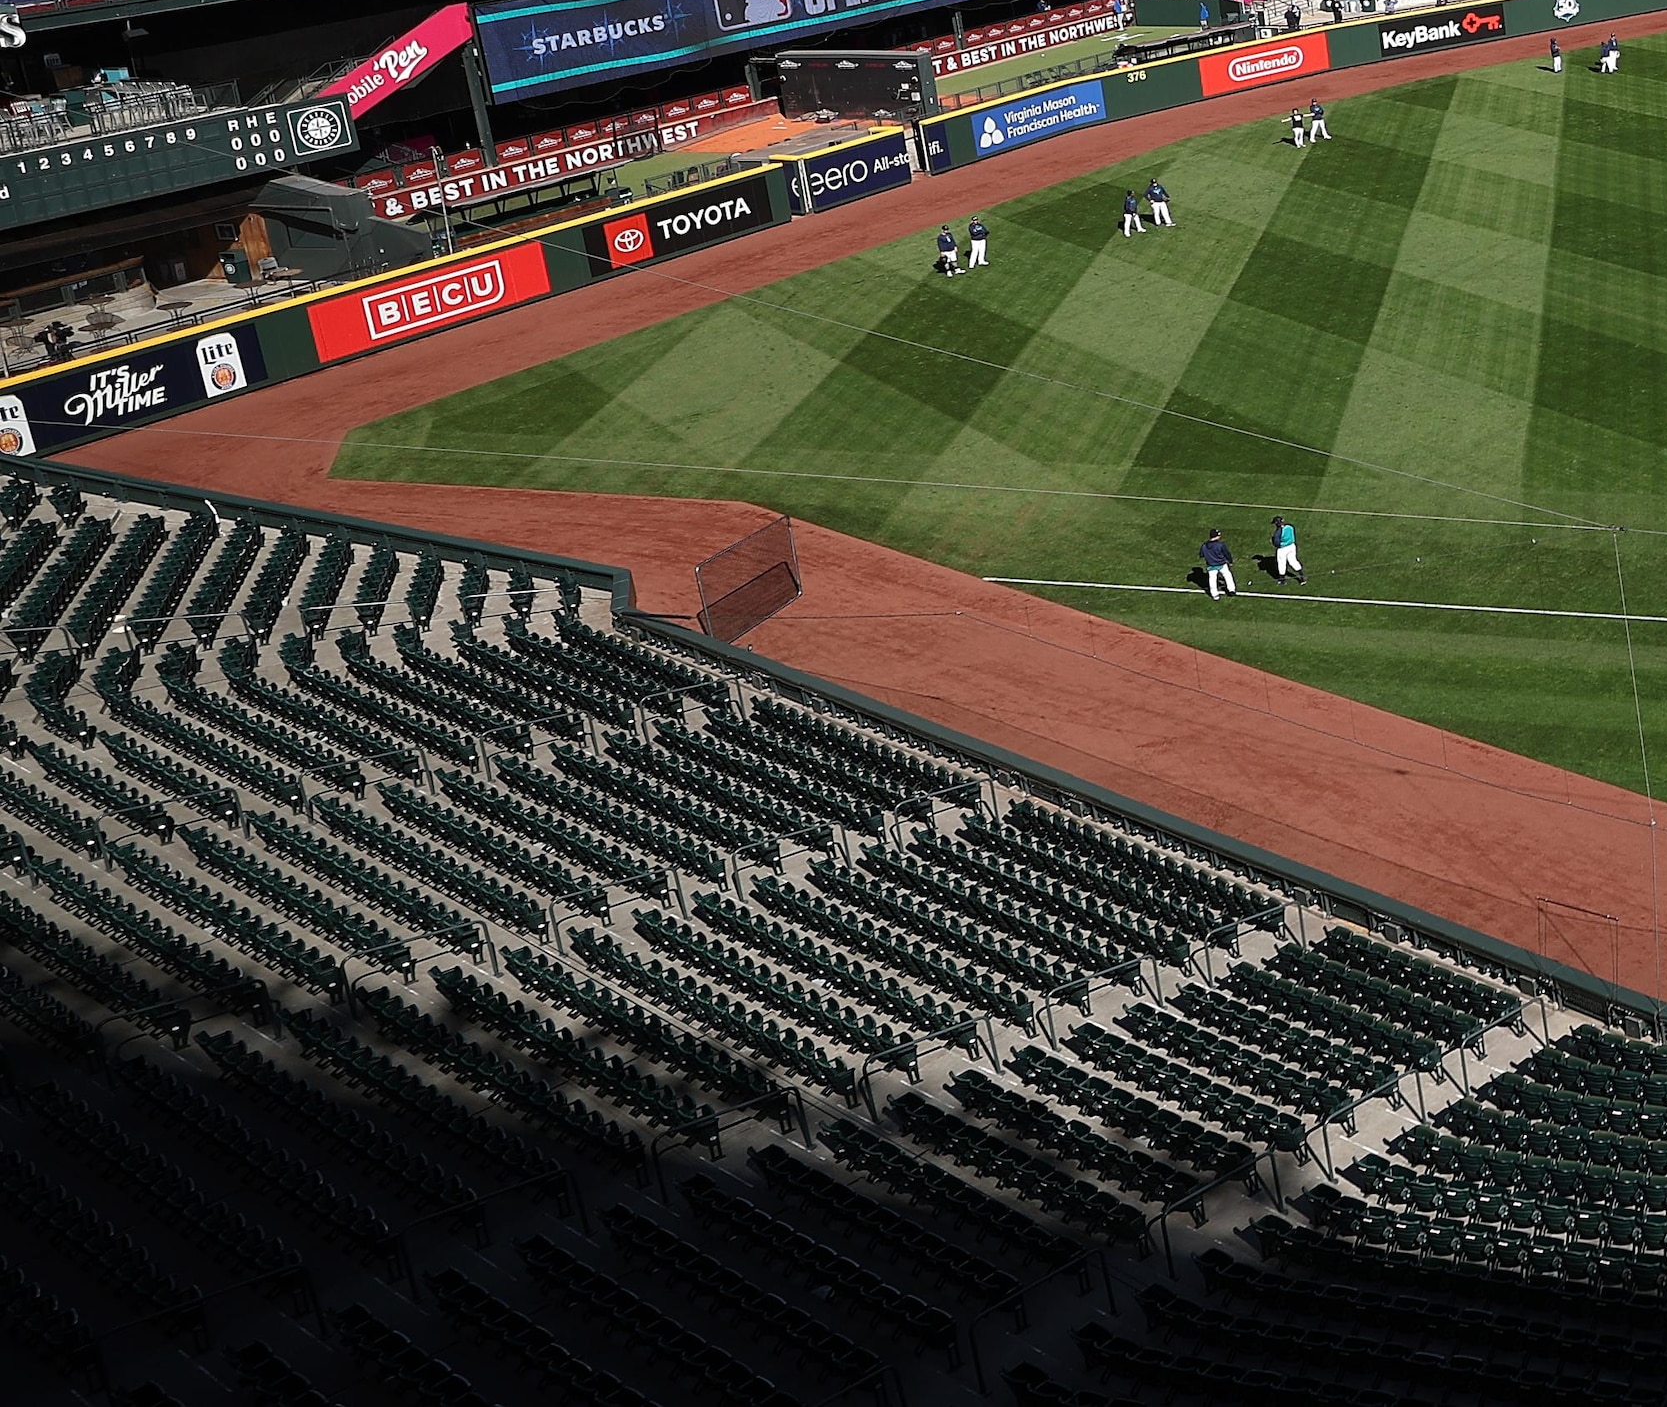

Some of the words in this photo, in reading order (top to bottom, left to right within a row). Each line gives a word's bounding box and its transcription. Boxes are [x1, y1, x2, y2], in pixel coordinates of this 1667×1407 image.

[1558, 0, 1574, 12] 50
[532, 15, 666, 55] STARBUCKS
[1382, 20, 1461, 50] KeyBank
[947, 58, 958, 70] &
[961, 46, 998, 67] BEST
[1001, 38, 1018, 57] IN
[1018, 33, 1047, 52] THE
[1235, 52, 1298, 77] Nintendo
[1127, 71, 1147, 83] 376
[1004, 105, 1042, 125] Virginia
[1043, 95, 1076, 113] Mason
[1006, 116, 1060, 139] Franciscan
[1060, 103, 1097, 123] Health
[17, 161, 27, 174] 1
[38, 157, 51, 171] 2
[60, 153, 72, 166] 3
[82, 148, 94, 161] 4
[104, 143, 115, 157] 5
[124, 140, 136, 153] 6
[144, 136, 156, 149] 7
[166, 131, 177, 145] 8
[186, 127, 197, 141] 9
[227, 119, 240, 132] R
[246, 115, 259, 129] H
[265, 112, 277, 125] E
[385, 198, 405, 216] &
[410, 178, 476, 210] BEST
[481, 172, 508, 191] IN
[509, 157, 560, 183] THE
[564, 121, 699, 170] NORTHWEST
[657, 197, 751, 239] TOYOTA
[201, 341, 234, 366] Lite
[89, 365, 130, 392] IT'S
[64, 362, 164, 426] Miller
[116, 386, 166, 416] TIME
